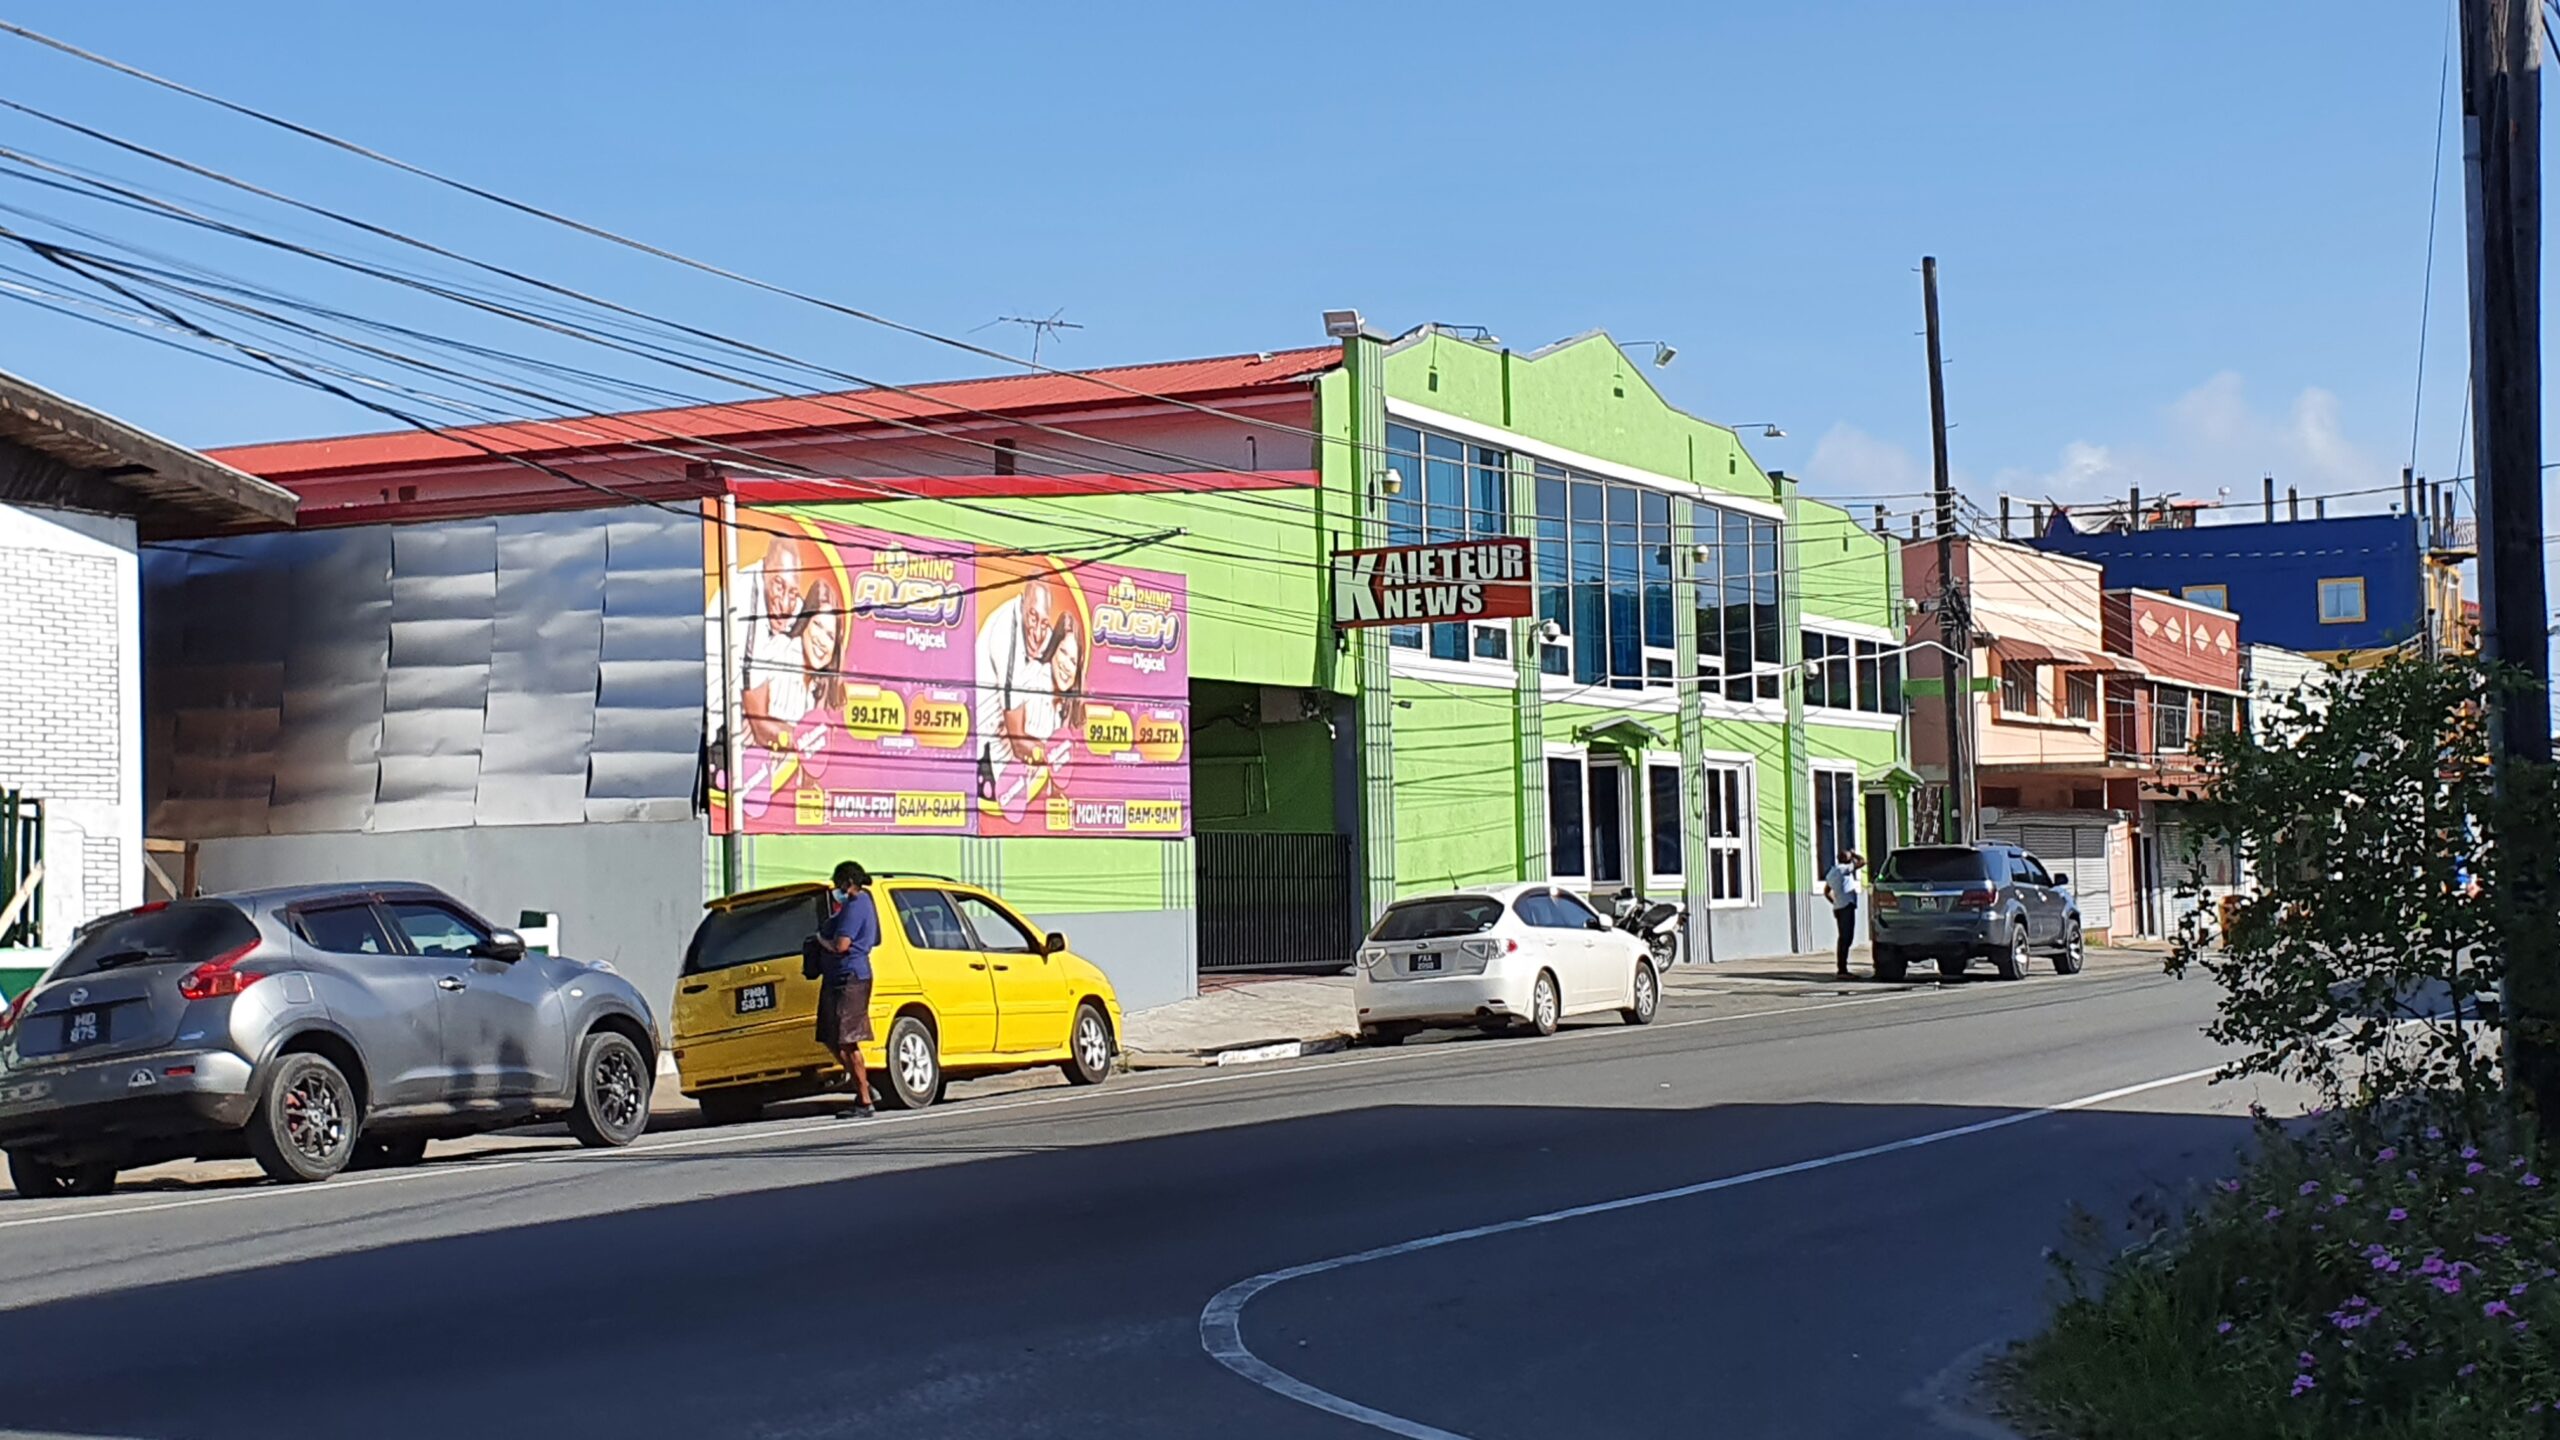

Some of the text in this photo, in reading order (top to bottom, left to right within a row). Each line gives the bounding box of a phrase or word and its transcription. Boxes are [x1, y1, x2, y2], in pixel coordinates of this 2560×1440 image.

[1335, 544, 1524, 621] KAIETEUR
[854, 573, 965, 627] RUSH
[1384, 584, 1483, 620] NEWS
[906, 627, 947, 651] Digicel
[1092, 606, 1180, 652] RUSH
[1133, 652, 1166, 674] Digicel
[851, 705, 899, 724] 99.1FM
[914, 709, 961, 728] 99.5FM
[1090, 724, 1127, 743] 99.1FM
[1140, 727, 1178, 743] 99.5FM
[832, 795, 894, 818] MON-FRI
[1075, 803, 1124, 824] MON-FRI
[1127, 807, 1178, 824] 6AM-9AM
[741, 996, 769, 1011] 5831
[70, 1025, 97, 1042] 875
